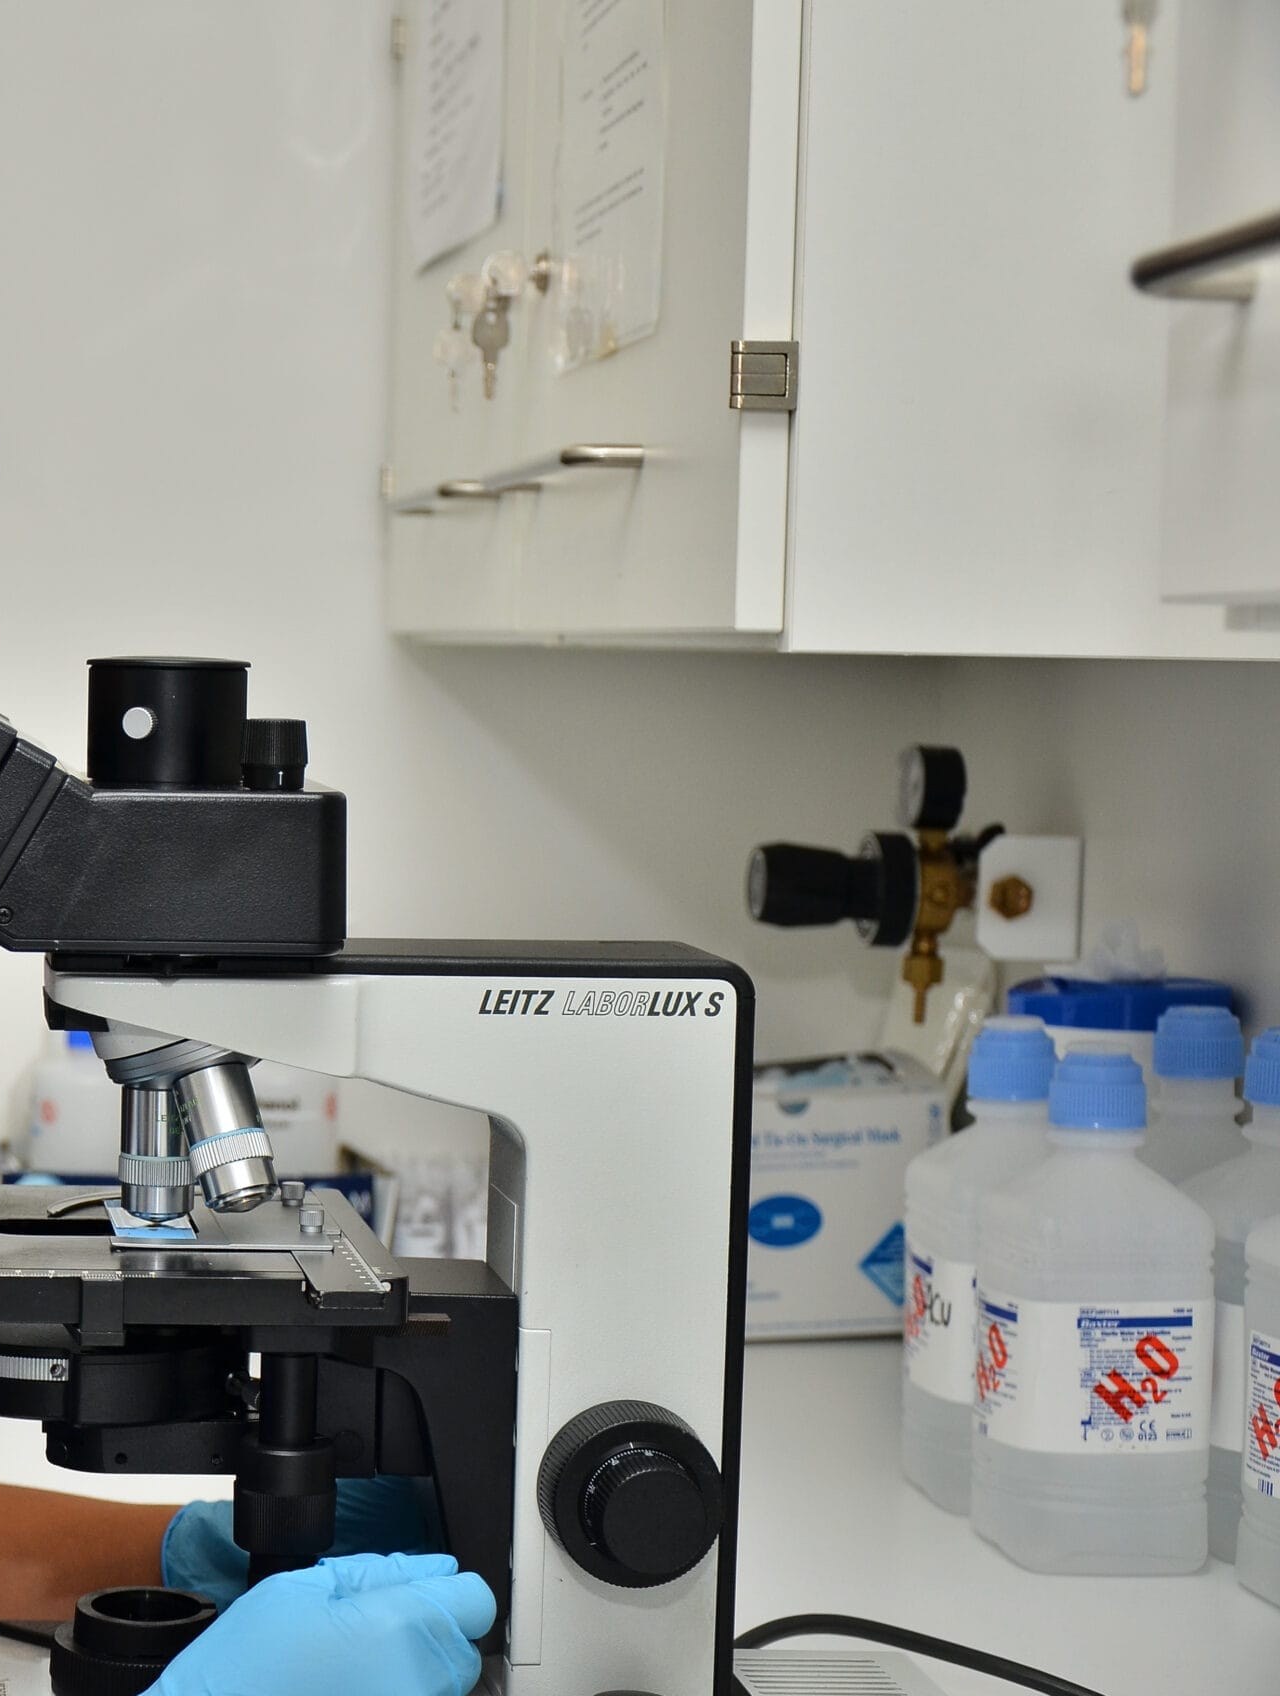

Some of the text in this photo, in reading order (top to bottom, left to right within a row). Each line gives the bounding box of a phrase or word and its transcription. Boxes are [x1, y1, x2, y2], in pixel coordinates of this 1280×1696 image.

[478, 989, 725, 1017] LEITZ LABORLUX S
[1081, 1319, 1120, 1328] Baxter
[1093, 1333, 1179, 1424] H2O
[1138, 1432, 1158, 1441] 0123
